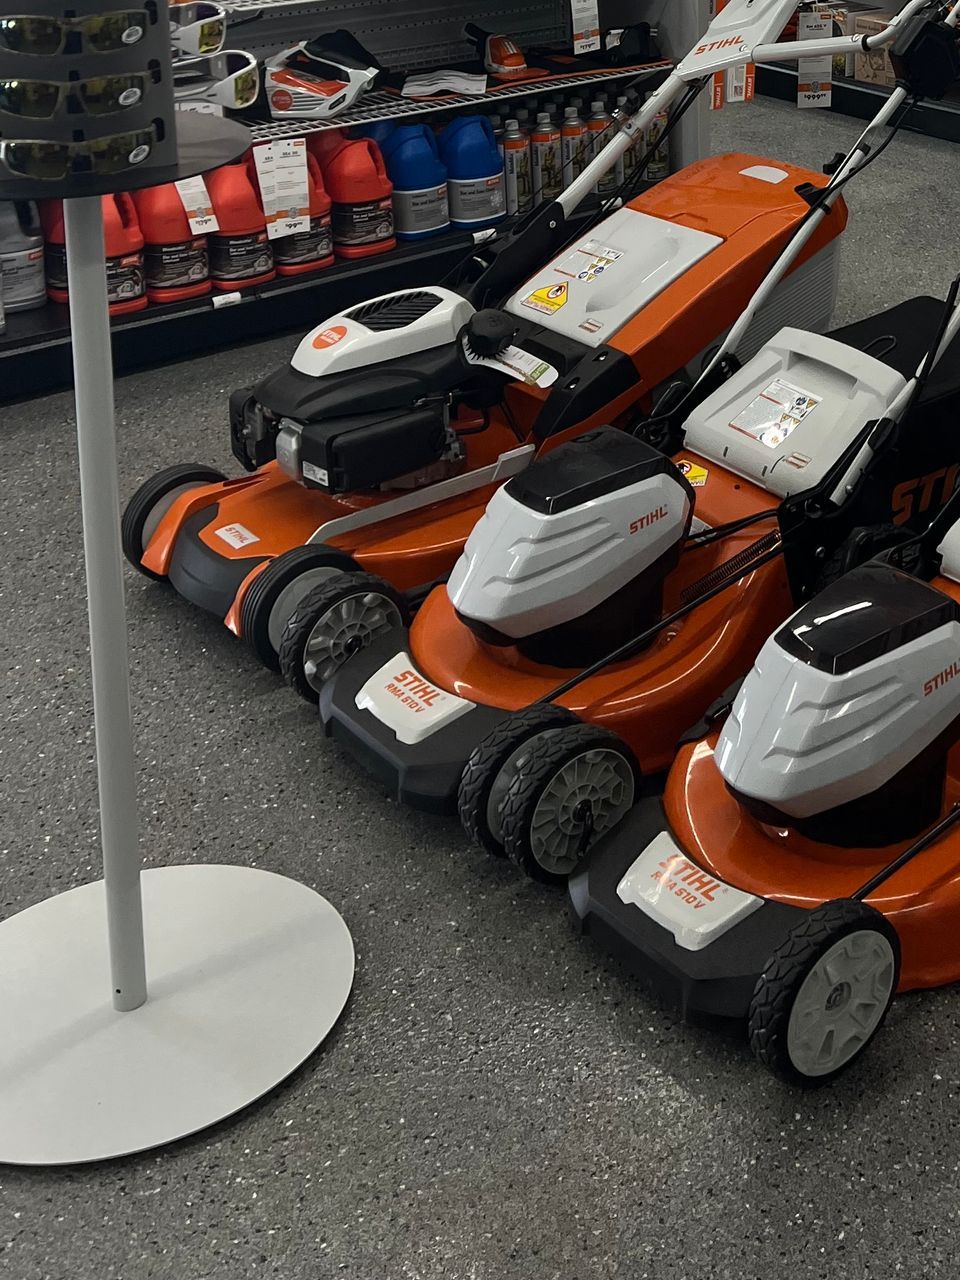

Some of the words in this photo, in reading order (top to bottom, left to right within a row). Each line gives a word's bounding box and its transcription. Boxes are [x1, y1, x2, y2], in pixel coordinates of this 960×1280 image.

[695, 35, 744, 55] STIHL
[224, 527, 250, 544] STIHL
[629, 507, 667, 535] STIHL
[393, 670, 441, 707] STIHL
[924, 662, 960, 696] STIHL
[384, 683, 405, 699] RMA
[401, 696, 418, 709] 510
[415, 705, 426, 713] V
[658, 854, 722, 902] STIHL
[675, 887, 697, 905] 510
[693, 901, 706, 909] V
